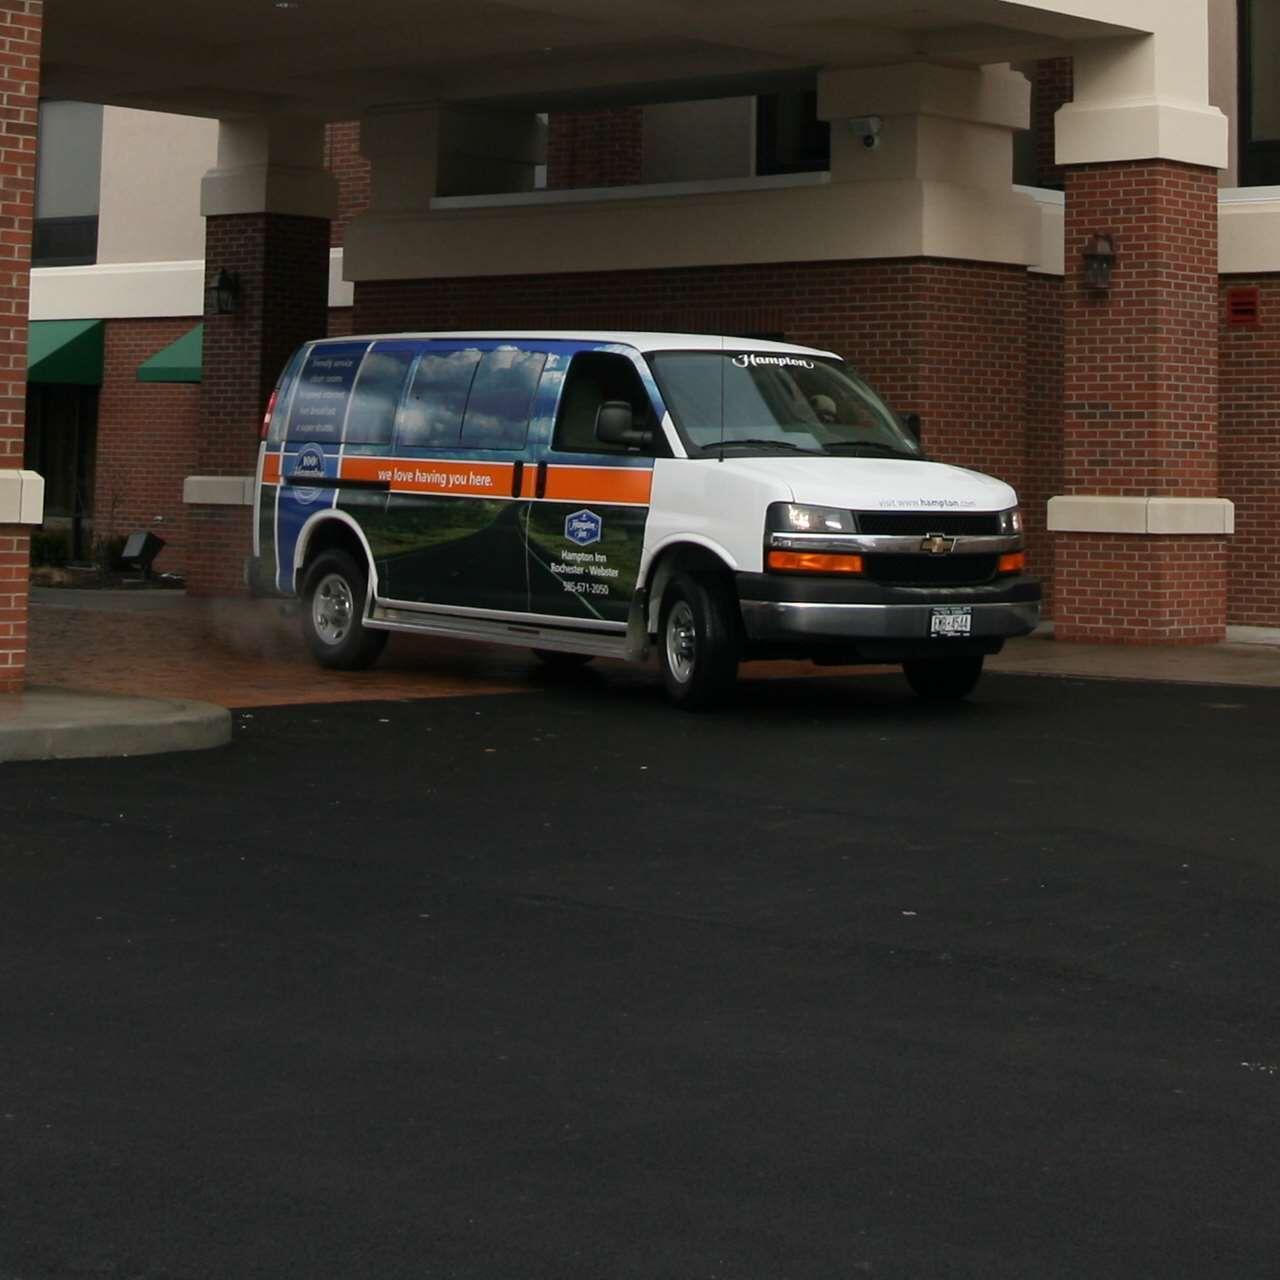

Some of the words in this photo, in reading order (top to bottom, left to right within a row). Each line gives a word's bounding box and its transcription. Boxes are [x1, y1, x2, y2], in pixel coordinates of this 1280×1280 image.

[731, 353, 815, 369] Hampton
[377, 469, 392, 481] we
[393, 467, 413, 482] love
[414, 468, 447, 488] having
[447, 474, 467, 488] you
[469, 471, 493, 487] here.
[561, 549, 594, 564] Hampton
[595, 552, 606, 562] Inn
[550, 562, 584, 575] Rochester
[589, 565, 619, 577] Webster
